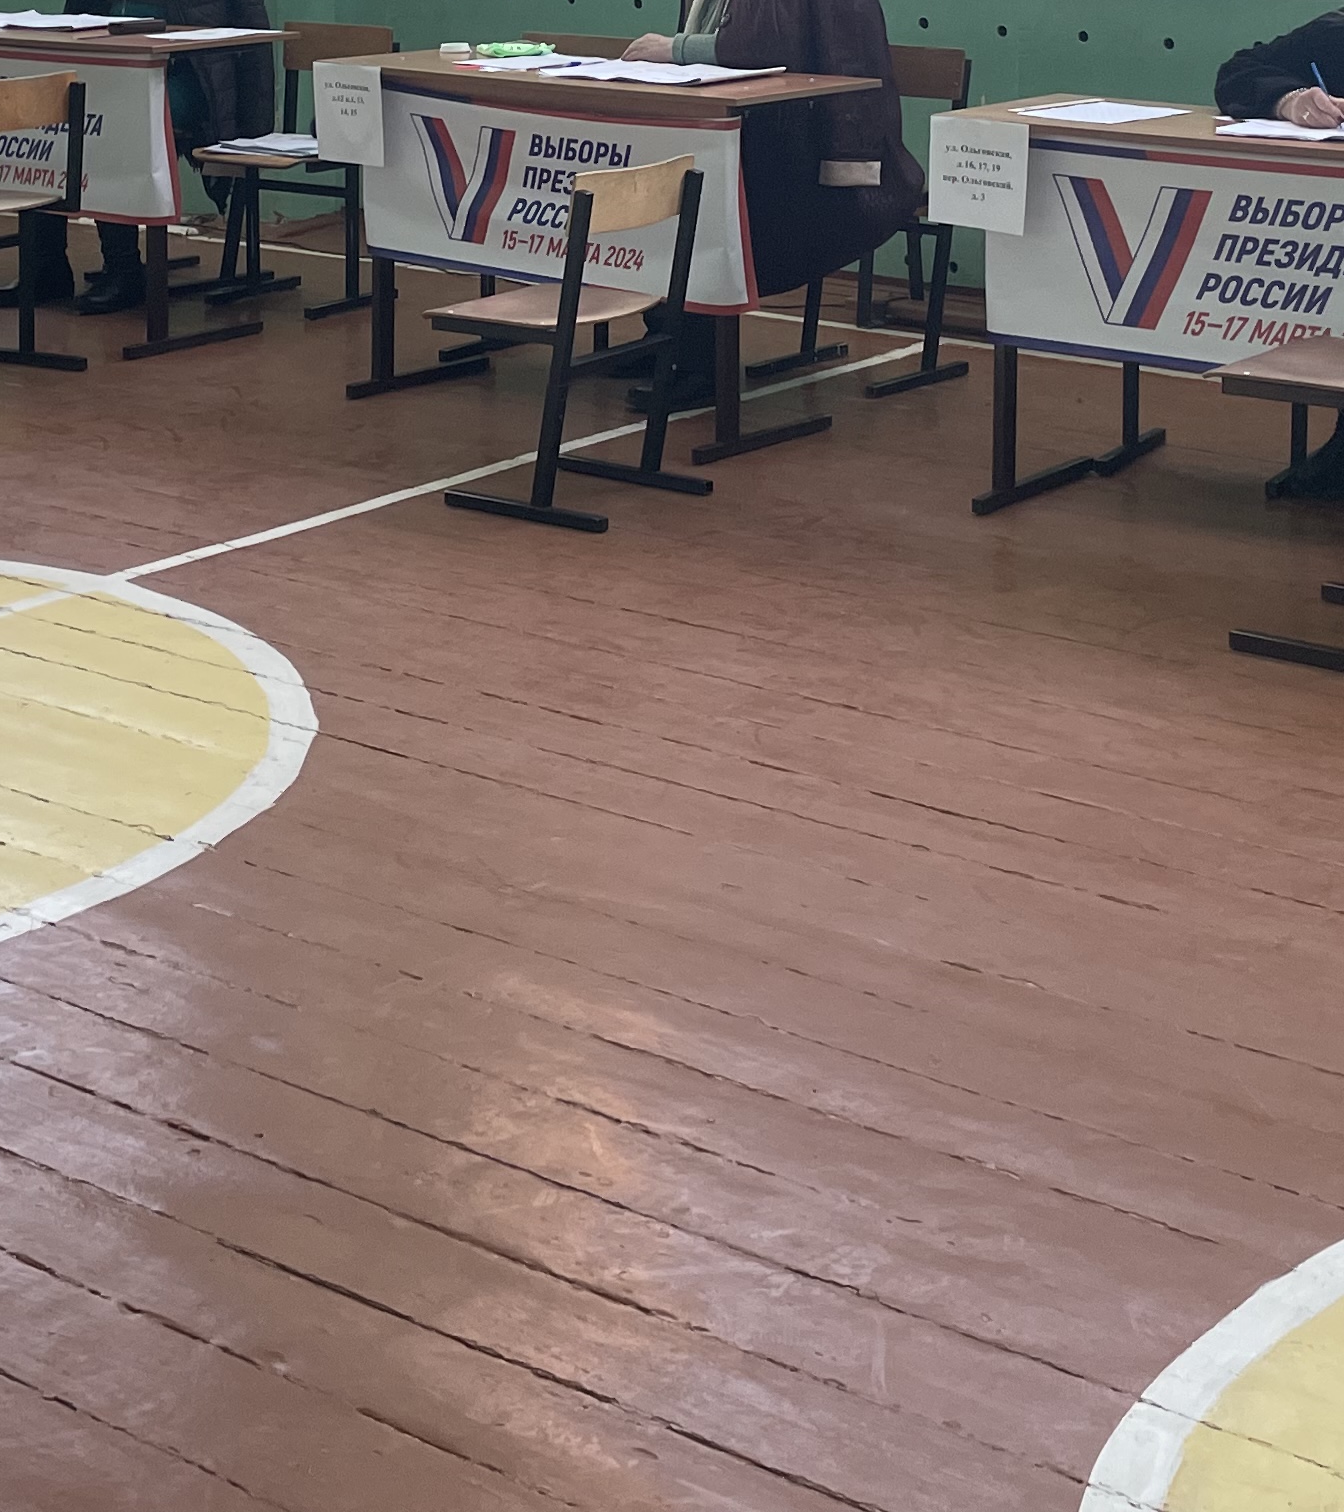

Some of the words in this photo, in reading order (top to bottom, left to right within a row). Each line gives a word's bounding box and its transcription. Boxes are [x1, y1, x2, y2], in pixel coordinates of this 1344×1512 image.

[528, 133, 632, 167] ВЫБОРЫ
[12, 166, 55, 188] МАРТА
[57, 171, 89, 192] 24
[507, 198, 570, 230] РОСС
[546, 237, 601, 264] МАТА
[604, 246, 645, 271] 2024
[1195, 272, 1333, 315] РОССИИ
